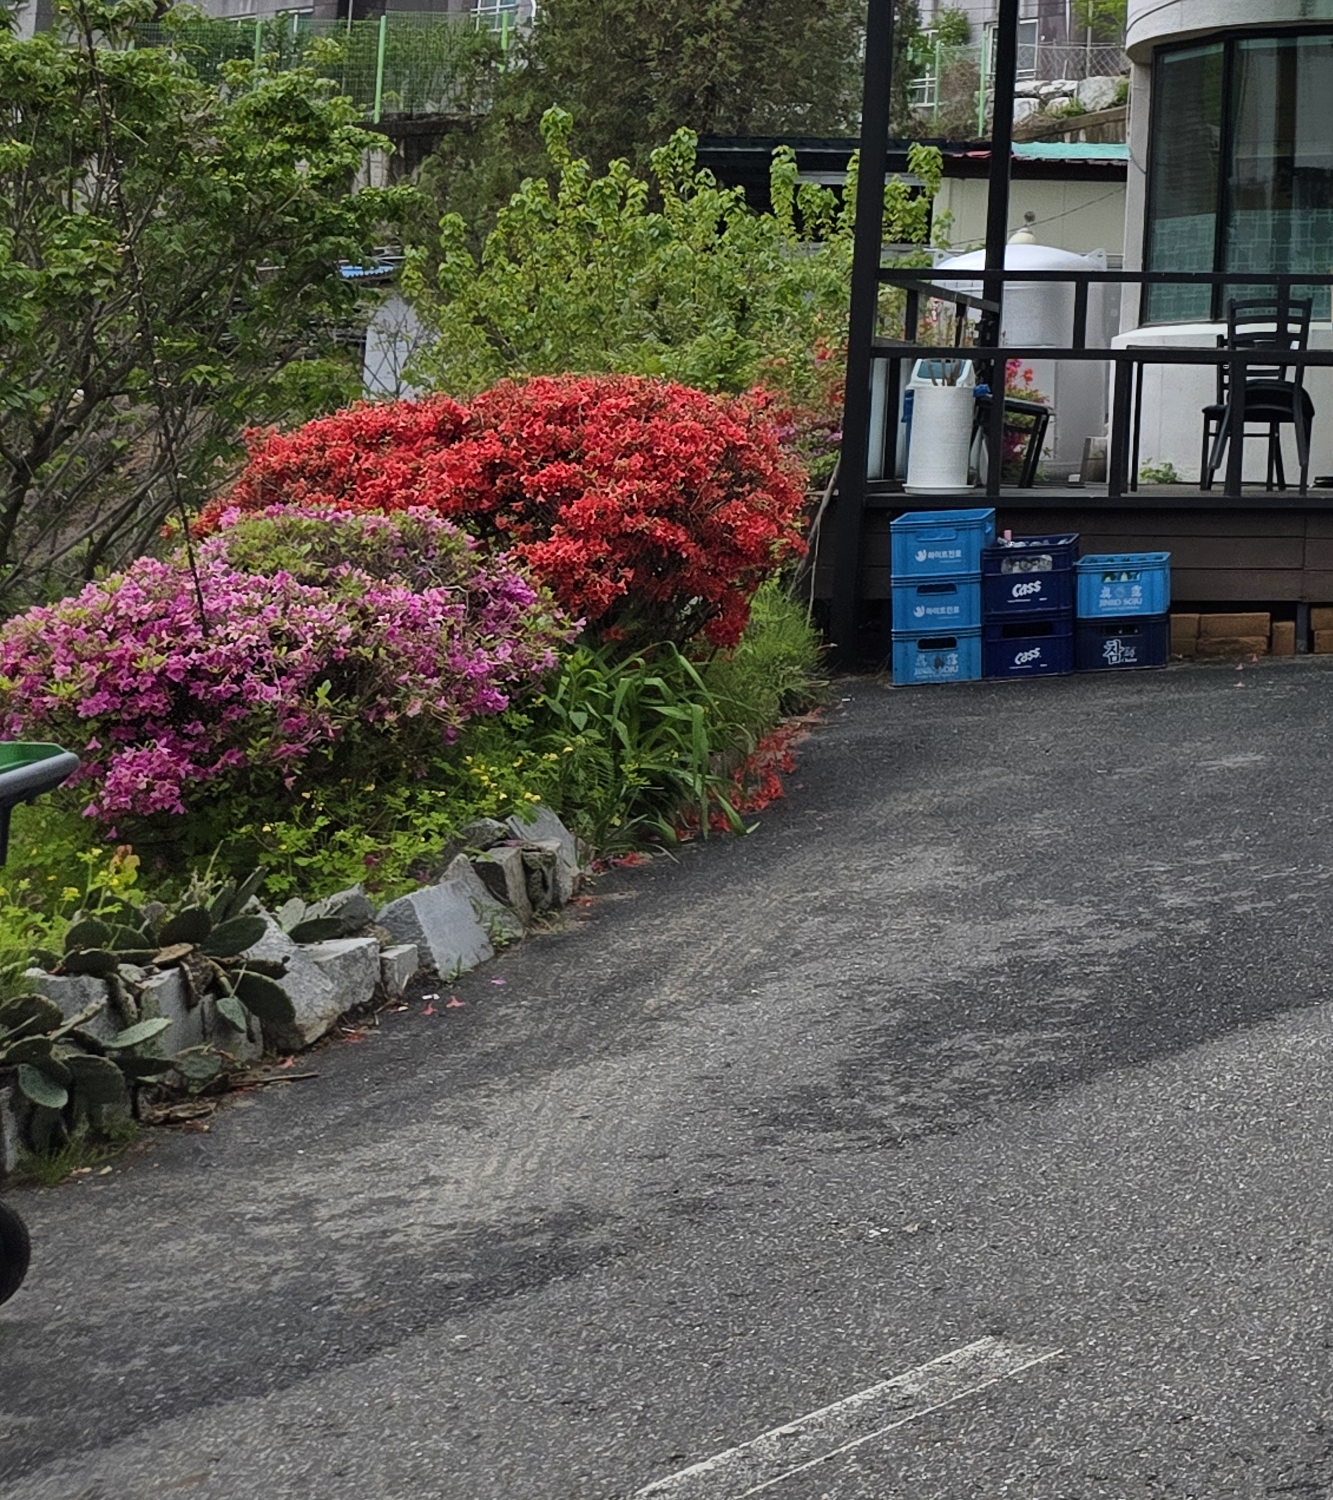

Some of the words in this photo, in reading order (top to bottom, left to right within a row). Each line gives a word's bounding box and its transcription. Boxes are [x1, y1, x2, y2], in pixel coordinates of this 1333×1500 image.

[928, 549, 962, 560] 하이트진로
[1012, 580, 1042, 597] Cass
[926, 605, 960, 615] 하이트진로
[1014, 647, 1041, 665] Cass
